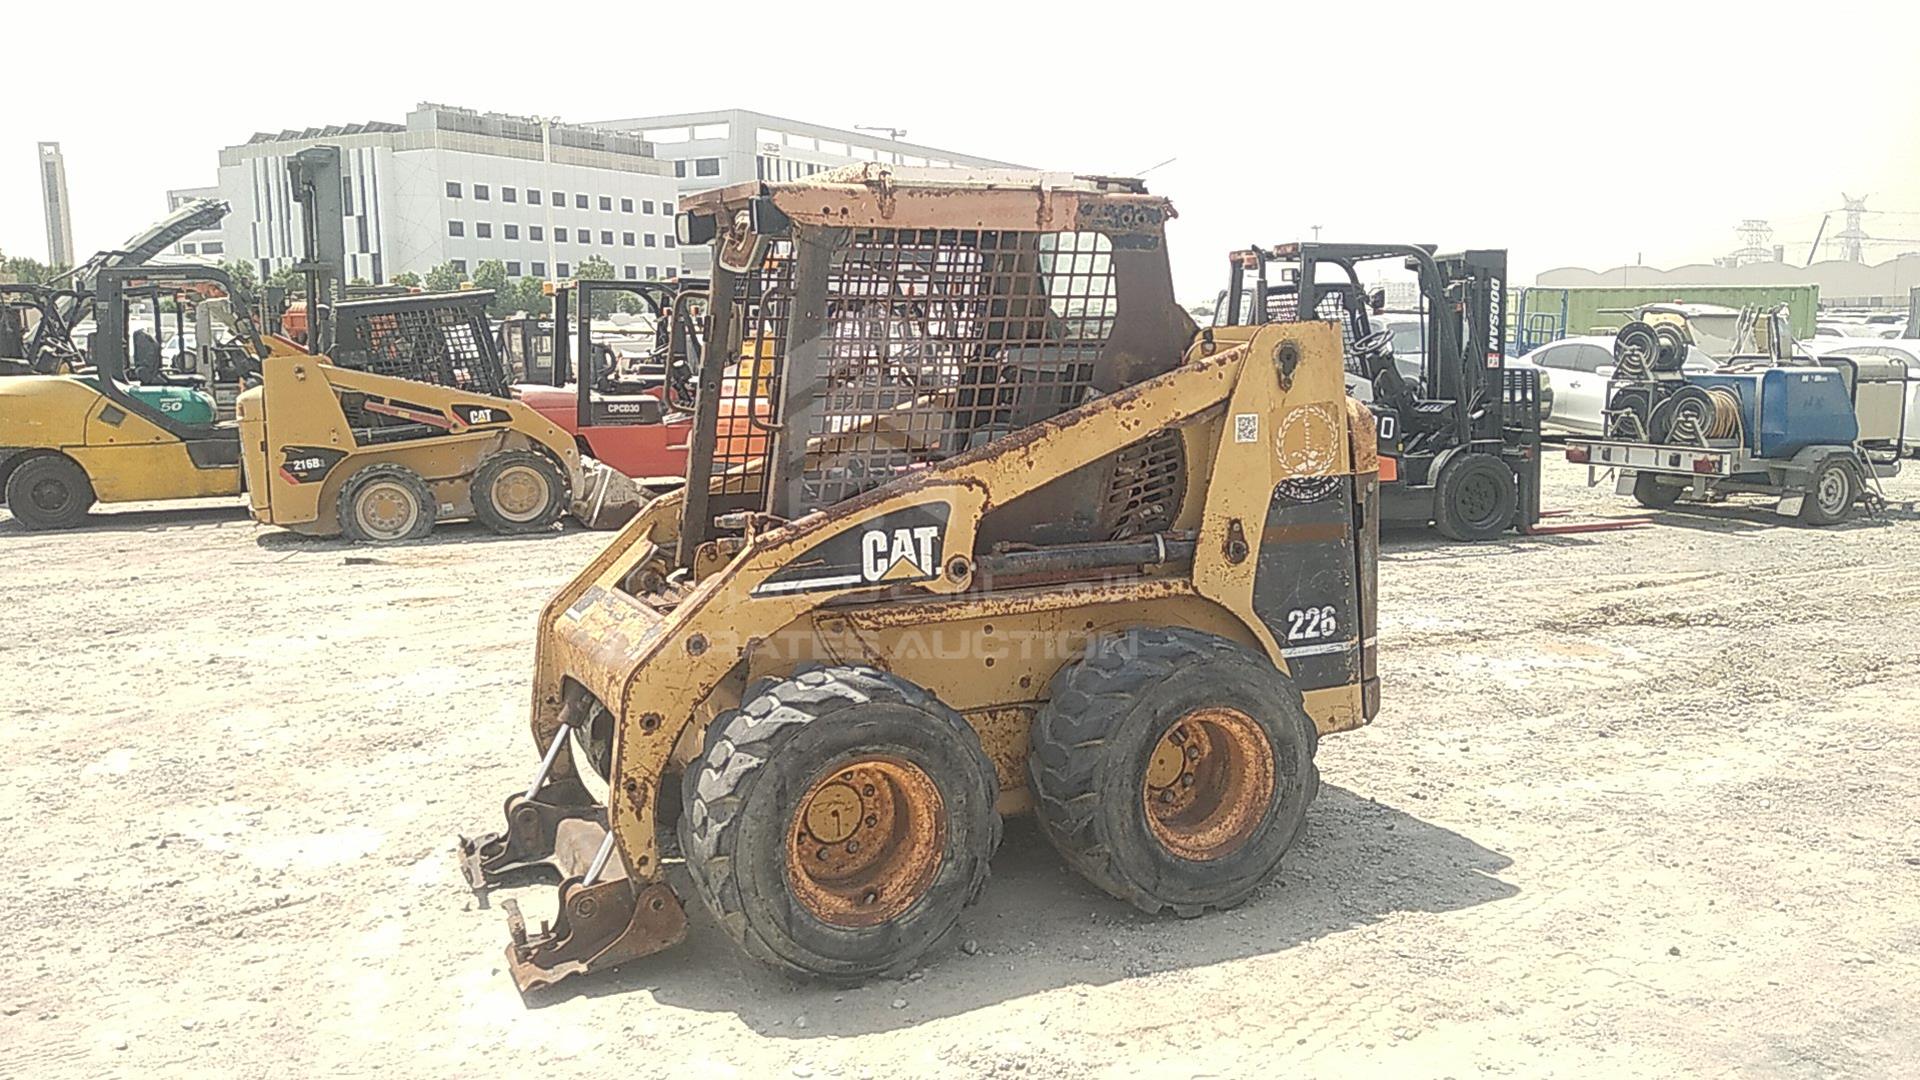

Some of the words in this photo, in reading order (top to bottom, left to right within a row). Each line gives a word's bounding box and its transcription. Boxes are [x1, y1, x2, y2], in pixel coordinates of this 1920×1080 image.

[1488, 277, 1500, 351] DOOSAN
[160, 402, 183, 412] 50
[469, 408, 492, 424] CAT
[607, 404, 640, 413] CPCD30
[1372, 415, 1394, 438] 0
[862, 526, 938, 581] CAT
[1287, 605, 1336, 640] 226
